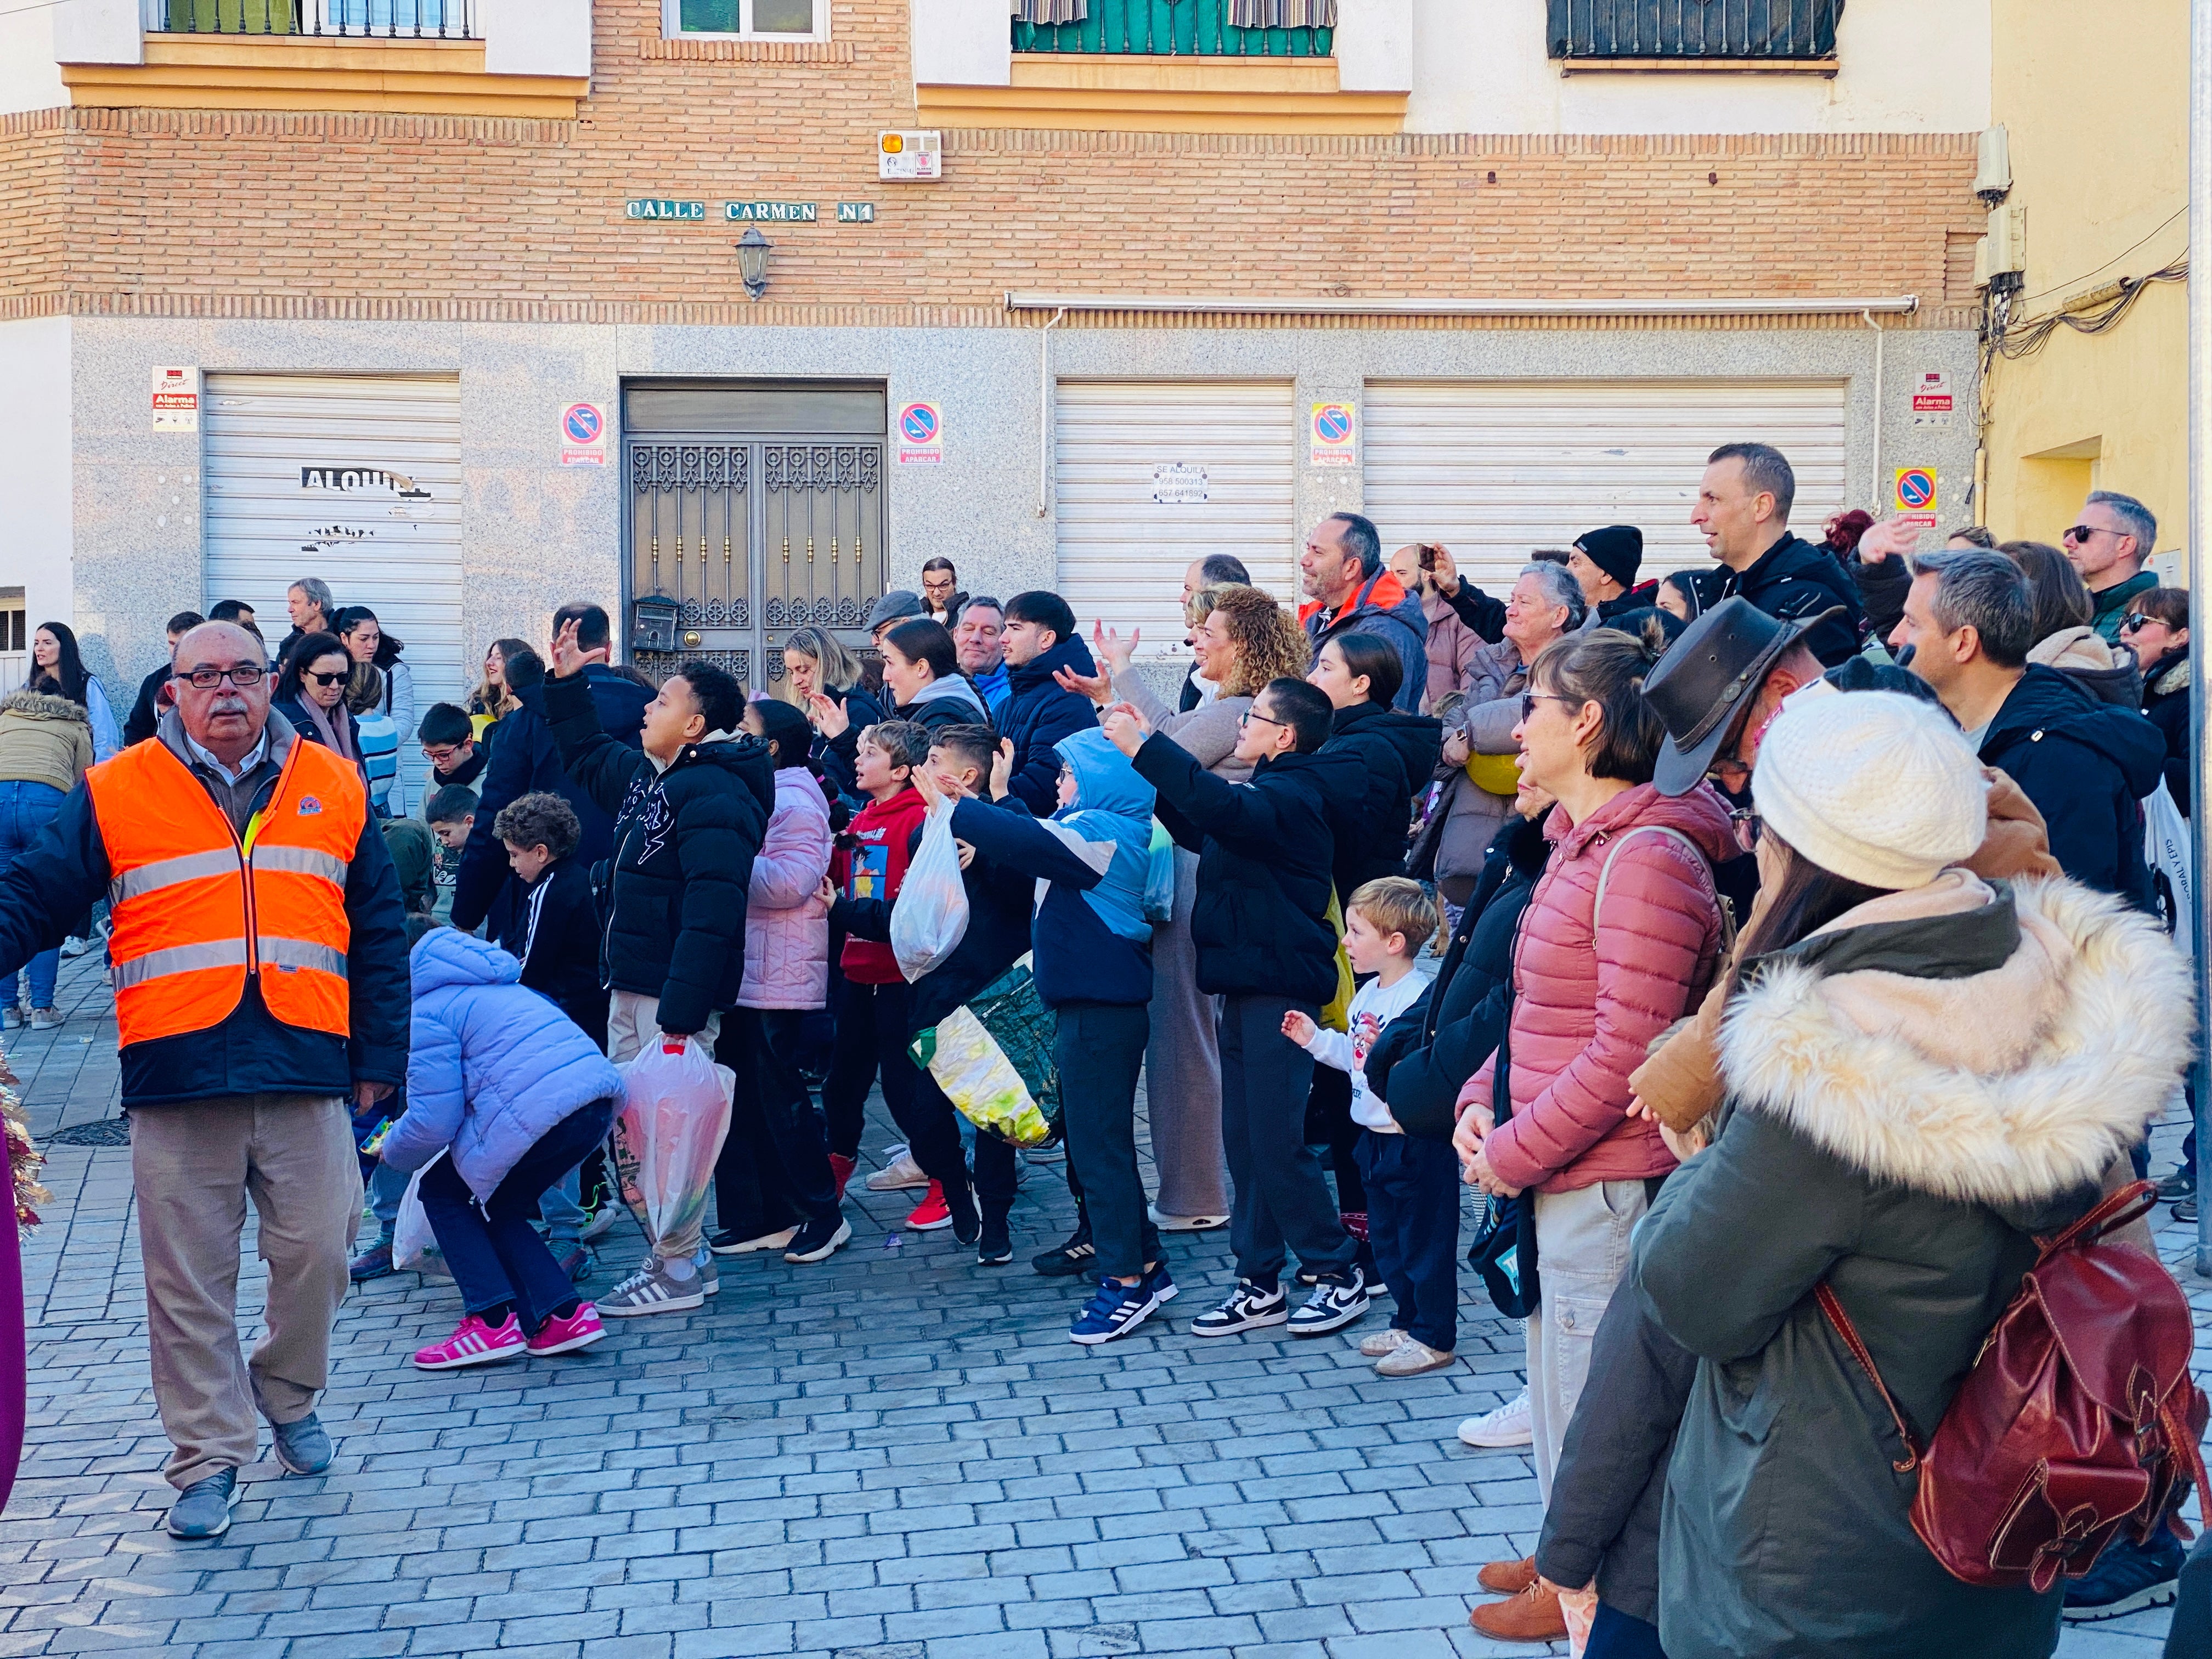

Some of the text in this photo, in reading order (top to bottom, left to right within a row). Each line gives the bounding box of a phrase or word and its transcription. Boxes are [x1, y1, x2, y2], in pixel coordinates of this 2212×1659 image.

[627, 199, 703, 218] CALLE
[726, 202, 816, 221] CARMEN
[156, 394, 195, 404] Alarma
[1915, 397, 1950, 405] Alarma
